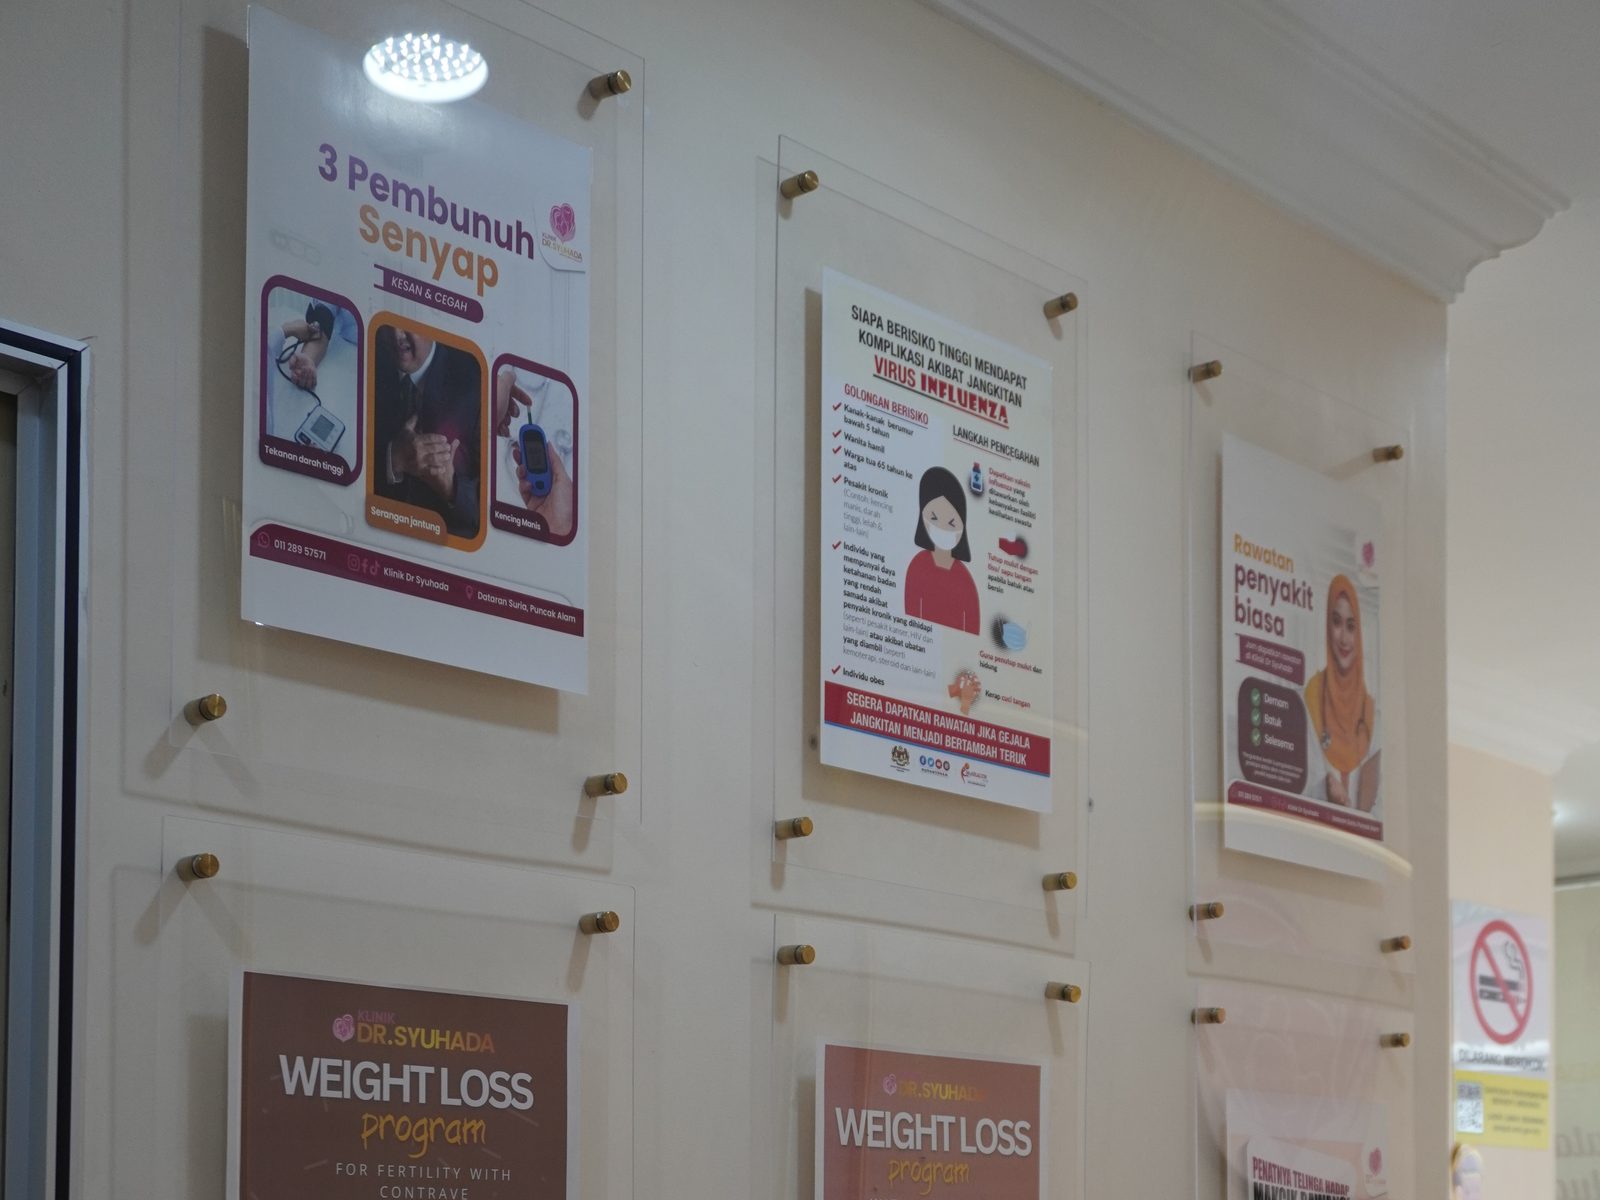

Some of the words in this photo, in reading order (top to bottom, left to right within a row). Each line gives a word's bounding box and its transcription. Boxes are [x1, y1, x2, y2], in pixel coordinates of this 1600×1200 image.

[318, 143, 338, 182] 3
[349, 155, 534, 260] Pembunuh
[359, 204, 499, 297] Senyap
[391, 276, 422, 297] KESAN
[424, 288, 432, 300] &
[435, 291, 468, 312] CEGAH
[851, 304, 884, 331] SIAPA
[887, 319, 935, 351] BERISIKO
[939, 340, 972, 367] TINGGI
[975, 357, 1027, 389] MENDAPAT
[859, 329, 924, 368] KOMPLIKASI
[928, 356, 964, 384] AKIBAT
[967, 373, 1022, 407] JANGKITAN
[874, 355, 915, 387] VIRUS
[921, 373, 1008, 424] INFLUENZA
[844, 384, 889, 410] GOLONGAN
[891, 401, 928, 425] BERISIKO
[844, 404, 885, 425] Kanak-kanak
[888, 421, 914, 436] berumur
[844, 416, 865, 428] bawah
[872, 427, 890, 438] tahun
[844, 432, 866, 447] Wanita
[868, 441, 885, 453] hamil
[953, 424, 988, 447] LANGKAH
[990, 440, 1039, 467] PENCEGAHAN
[264, 445, 298, 463] Tekanan
[299, 454, 321, 469] darah
[322, 460, 344, 476] tinggi
[844, 448, 864, 463] Warga
[866, 458, 876, 466] tua
[877, 461, 885, 469] 65
[887, 465, 904, 476] tahun
[844, 462, 856, 471] atas
[844, 477, 867, 488] Pesakit
[868, 485, 888, 498] kronik
[371, 506, 408, 526] Serangan
[409, 515, 440, 535] jantung
[494, 510, 518, 526] Kencing
[519, 518, 541, 531] Manis
[274, 539, 286, 549] 011
[287, 542, 303, 554] 289
[304, 547, 326, 561] 57571
[844, 542, 869, 557] Individu
[870, 551, 885, 562] yang
[1233, 533, 1294, 573] Rawatan
[384, 567, 405, 580] Klinik
[406, 572, 414, 582] Dr
[415, 575, 449, 592] Syuhada
[844, 556, 880, 573] mempunyai
[881, 566, 895, 576] daya
[844, 567, 876, 582] ketahanan
[877, 576, 896, 587] badan
[844, 579, 858, 589] yang
[860, 583, 881, 594] rendah
[844, 590, 867, 602] samada
[869, 597, 888, 608] akibat
[1235, 563, 1313, 611] penyakit
[477, 591, 508, 606] Dataran
[530, 604, 556, 620] Puncak
[557, 612, 576, 623] Alam
[844, 601, 871, 615] penyakit
[872, 608, 892, 620] kronik
[893, 616, 907, 626] yang
[909, 620, 932, 632] dihidapi
[1235, 596, 1285, 637] biasa
[844, 636, 858, 647] yang
[860, 639, 883, 651] diambil
[870, 632, 883, 641] atau
[885, 635, 903, 647] akibat
[905, 641, 925, 652] ubatan
[843, 668, 868, 681] Individu
[870, 675, 885, 686] obes
[985, 690, 1000, 701] Kerap
[1265, 693, 1289, 709] Demam
[847, 691, 882, 713] SEGERA
[886, 701, 931, 725] DAPATKAN
[934, 715, 975, 735] RAWATAN
[978, 726, 996, 741] JIKA
[999, 730, 1030, 749] GEJALA
[1265, 714, 1282, 727] Batuk
[851, 712, 901, 735] JANGKITAN
[904, 725, 943, 745] MENJADI
[945, 735, 997, 758] BERTAMBAH
[1000, 749, 1027, 765] TERUK
[1265, 735, 1294, 751] Selesema
[358, 1010, 396, 1024] KLINIK
[357, 1023, 495, 1053] DR.SYUHADA
[279, 1054, 435, 1103] WEIGHT
[441, 1068, 534, 1110] LOSS
[361, 1112, 486, 1158] program
[835, 1107, 956, 1152] WEIGHT
[960, 1117, 1032, 1157] LOSS
[336, 1163, 368, 1176] FOR
[378, 1164, 461, 1179] FERTILITY
[470, 1168, 511, 1181] WITH
[888, 1159, 970, 1196] program
[1253, 1157, 1291, 1186] PENATNYA
[1293, 1170, 1323, 1192] TELINGA
[1325, 1180, 1349, 1194] HADAP
[380, 1185, 469, 1200] CONTRAVE
